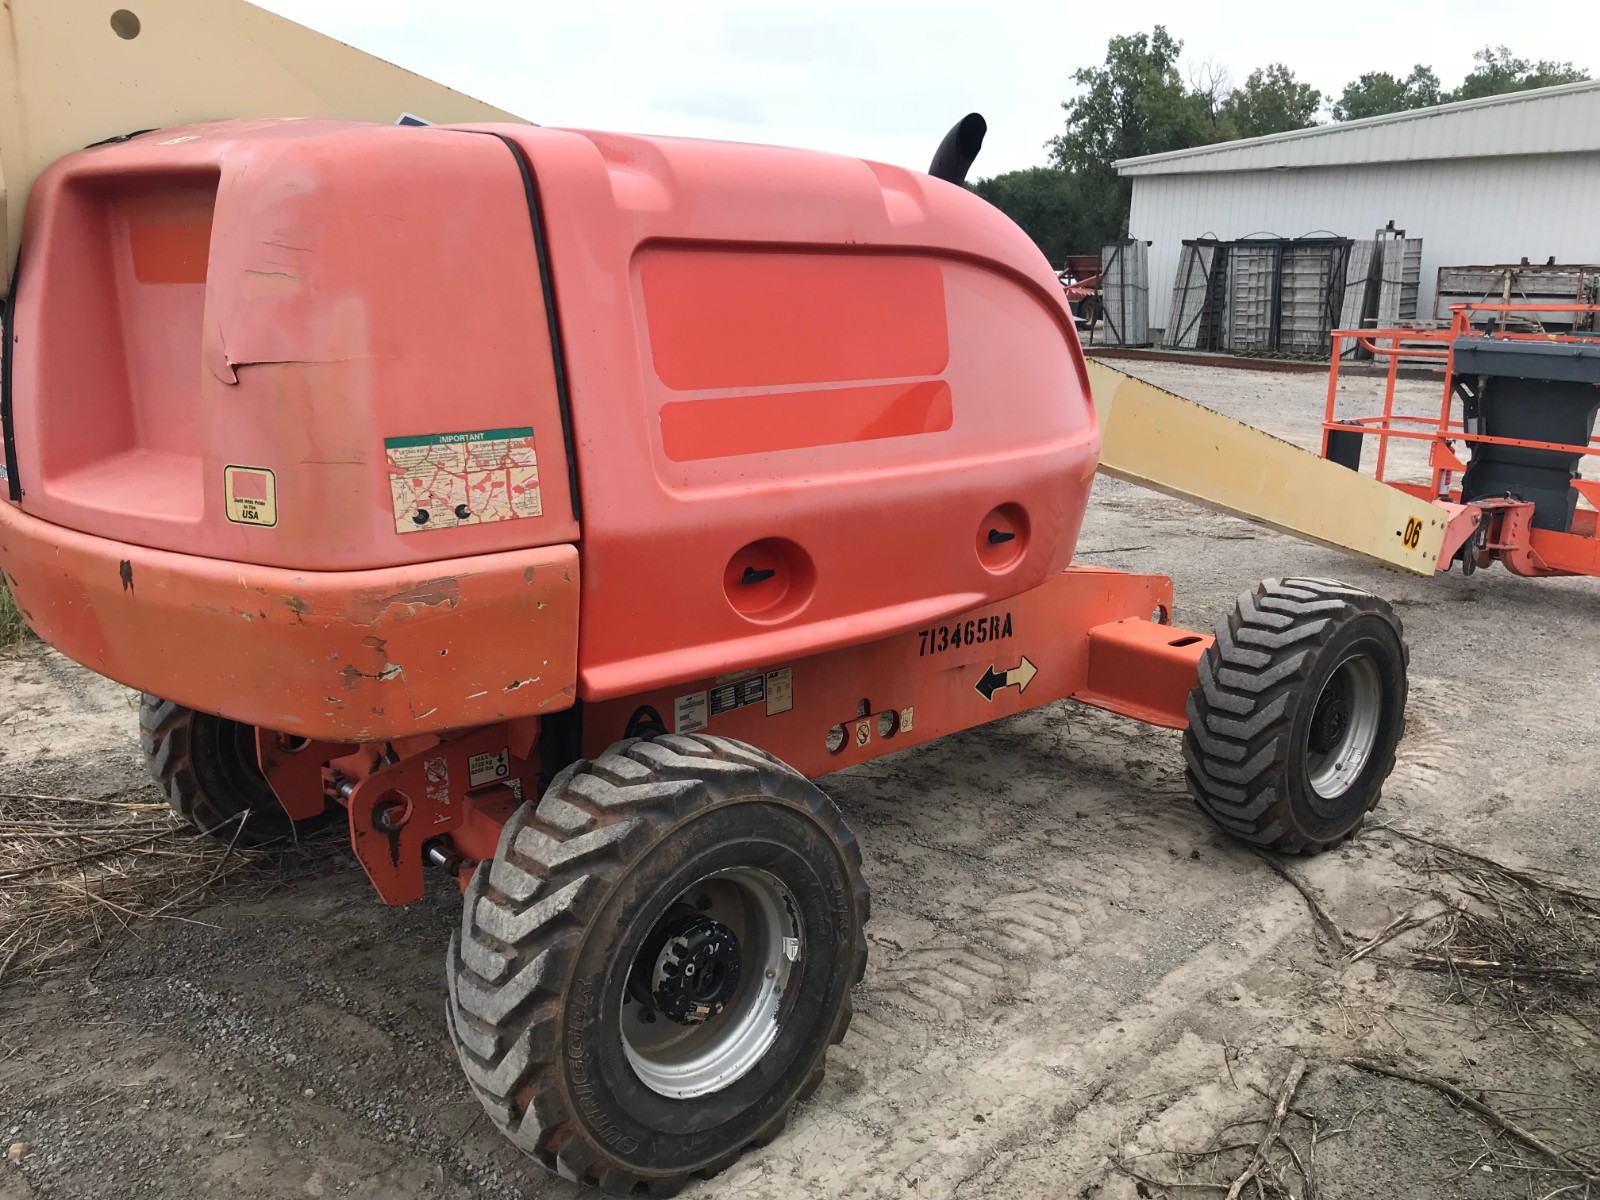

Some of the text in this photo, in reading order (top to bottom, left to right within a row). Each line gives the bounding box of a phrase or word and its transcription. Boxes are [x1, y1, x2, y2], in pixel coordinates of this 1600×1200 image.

[440, 433, 484, 443] IMPORTANT
[242, 510, 259, 520] USA
[1404, 518, 1422, 549] 06
[919, 613, 1013, 656] 713465RA
